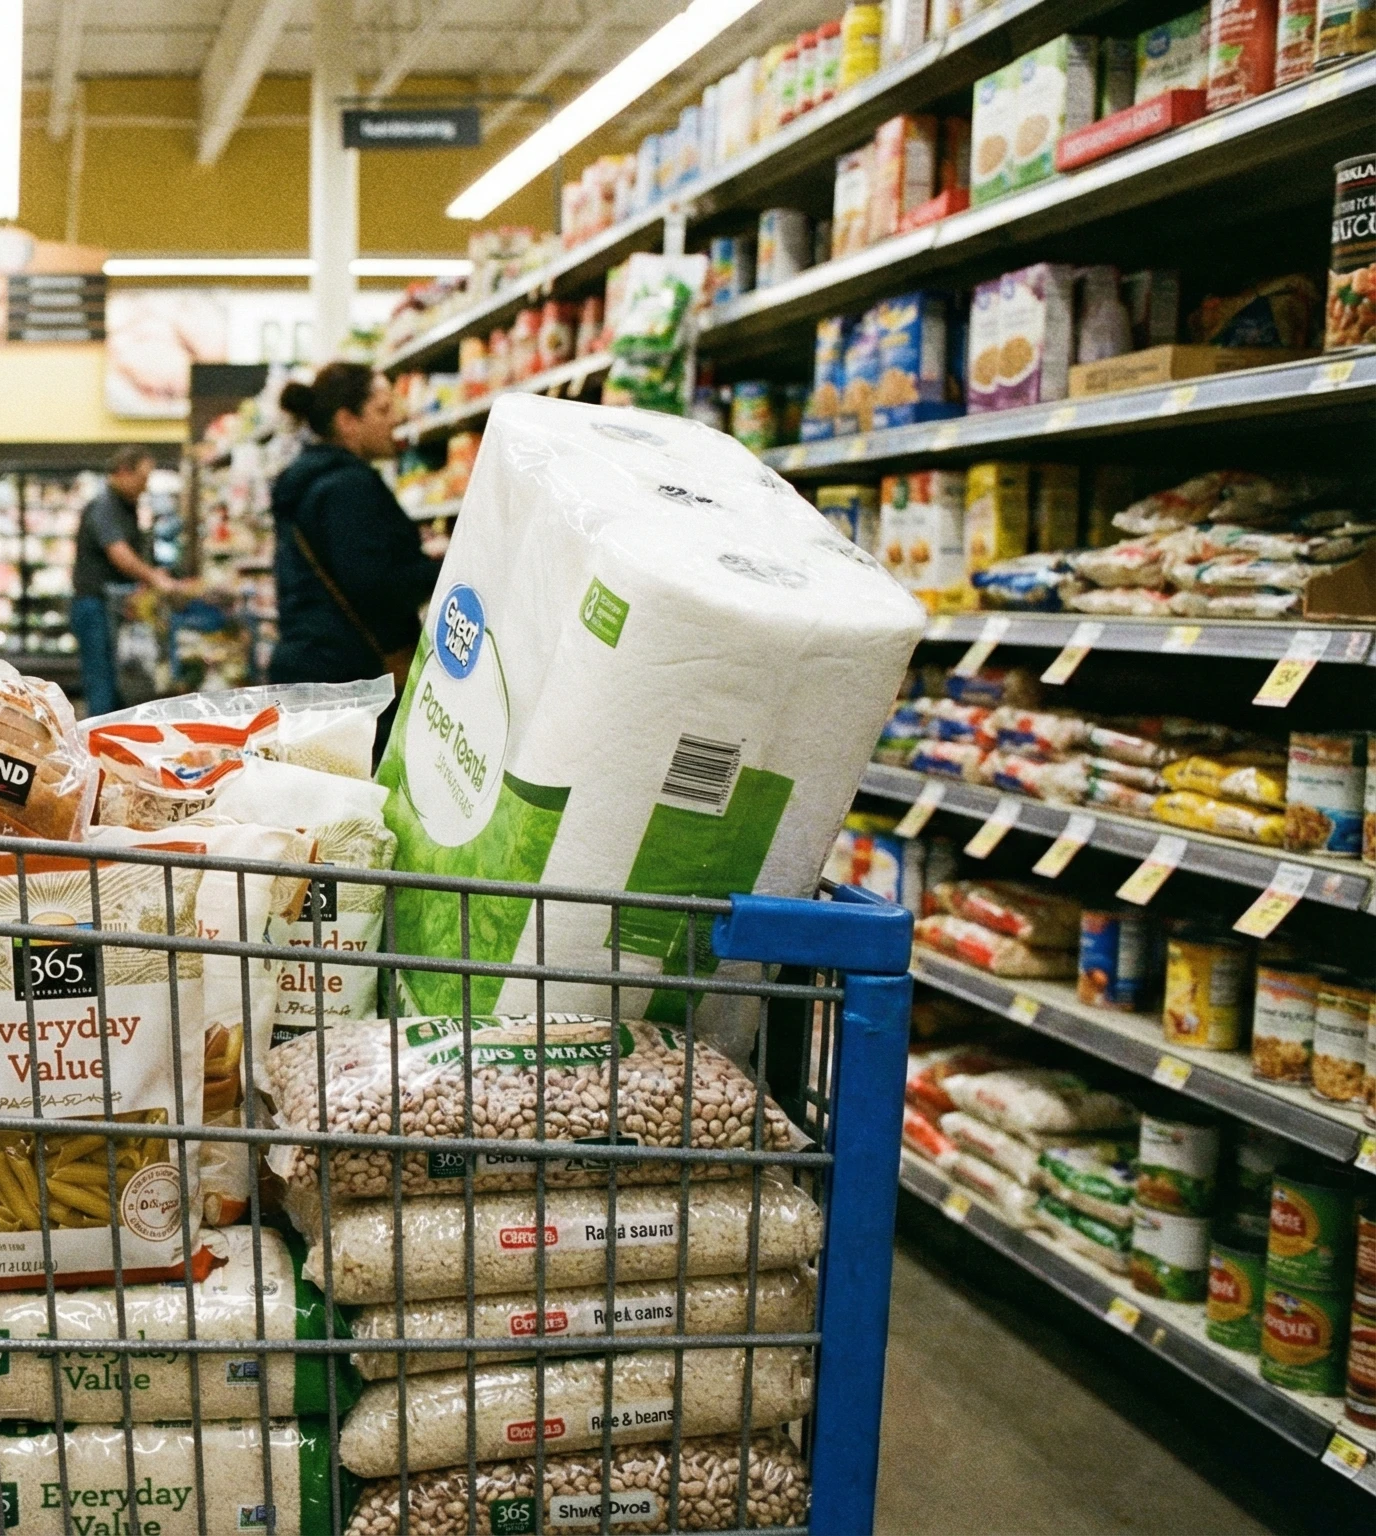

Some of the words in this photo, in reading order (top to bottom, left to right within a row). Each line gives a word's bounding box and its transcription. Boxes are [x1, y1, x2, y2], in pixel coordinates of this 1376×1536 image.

[445, 596, 479, 651] Great
[419, 681, 455, 744] Paper
[30, 948, 84, 986] 365
[277, 963, 343, 993] alue
[8, 1050, 104, 1083] Value
[62, 1363, 151, 1391] Value
[622, 1412, 633, 1426] &
[635, 1409, 674, 1425] beans
[40, 1477, 193, 1512] Everyday
[73, 1512, 162, 1536] Value
[497, 1502, 530, 1523] 365
